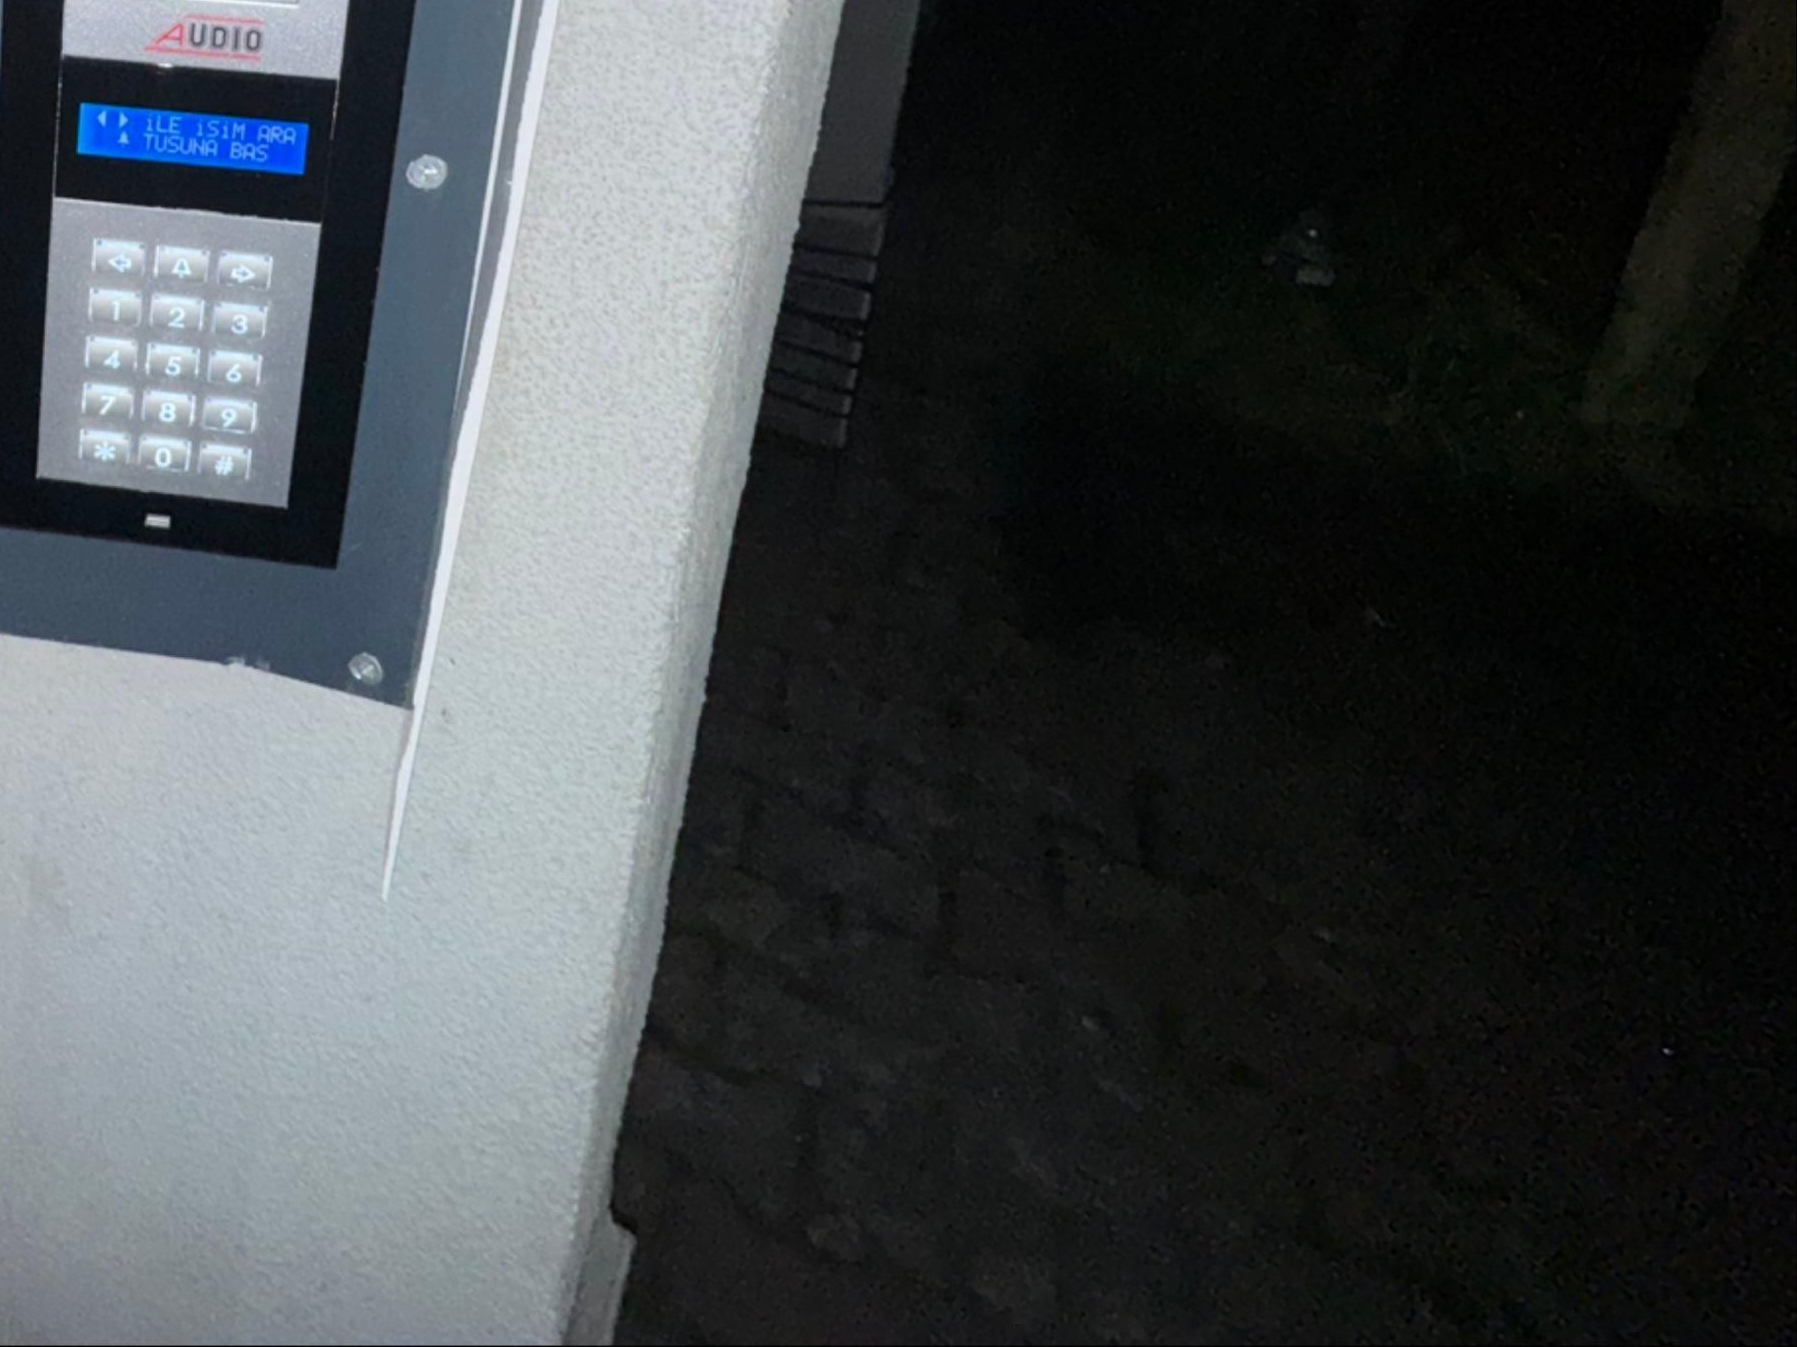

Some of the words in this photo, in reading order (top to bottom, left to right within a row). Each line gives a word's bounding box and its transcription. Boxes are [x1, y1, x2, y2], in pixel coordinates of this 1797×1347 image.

[150, 21, 263, 53] AUDIO
[143, 132, 218, 157] TUSUNA
[230, 143, 269, 163] BAS
[257, 125, 297, 146] ARA
[168, 307, 185, 329] 2
[230, 314, 248, 334] 3
[103, 350, 121, 370] 4
[165, 356, 182, 377] 5
[225, 363, 242, 384] 6
[100, 395, 116, 416] 7
[159, 403, 176, 423] 8
[220, 408, 237, 427] 9
[154, 447, 172, 468] 0
